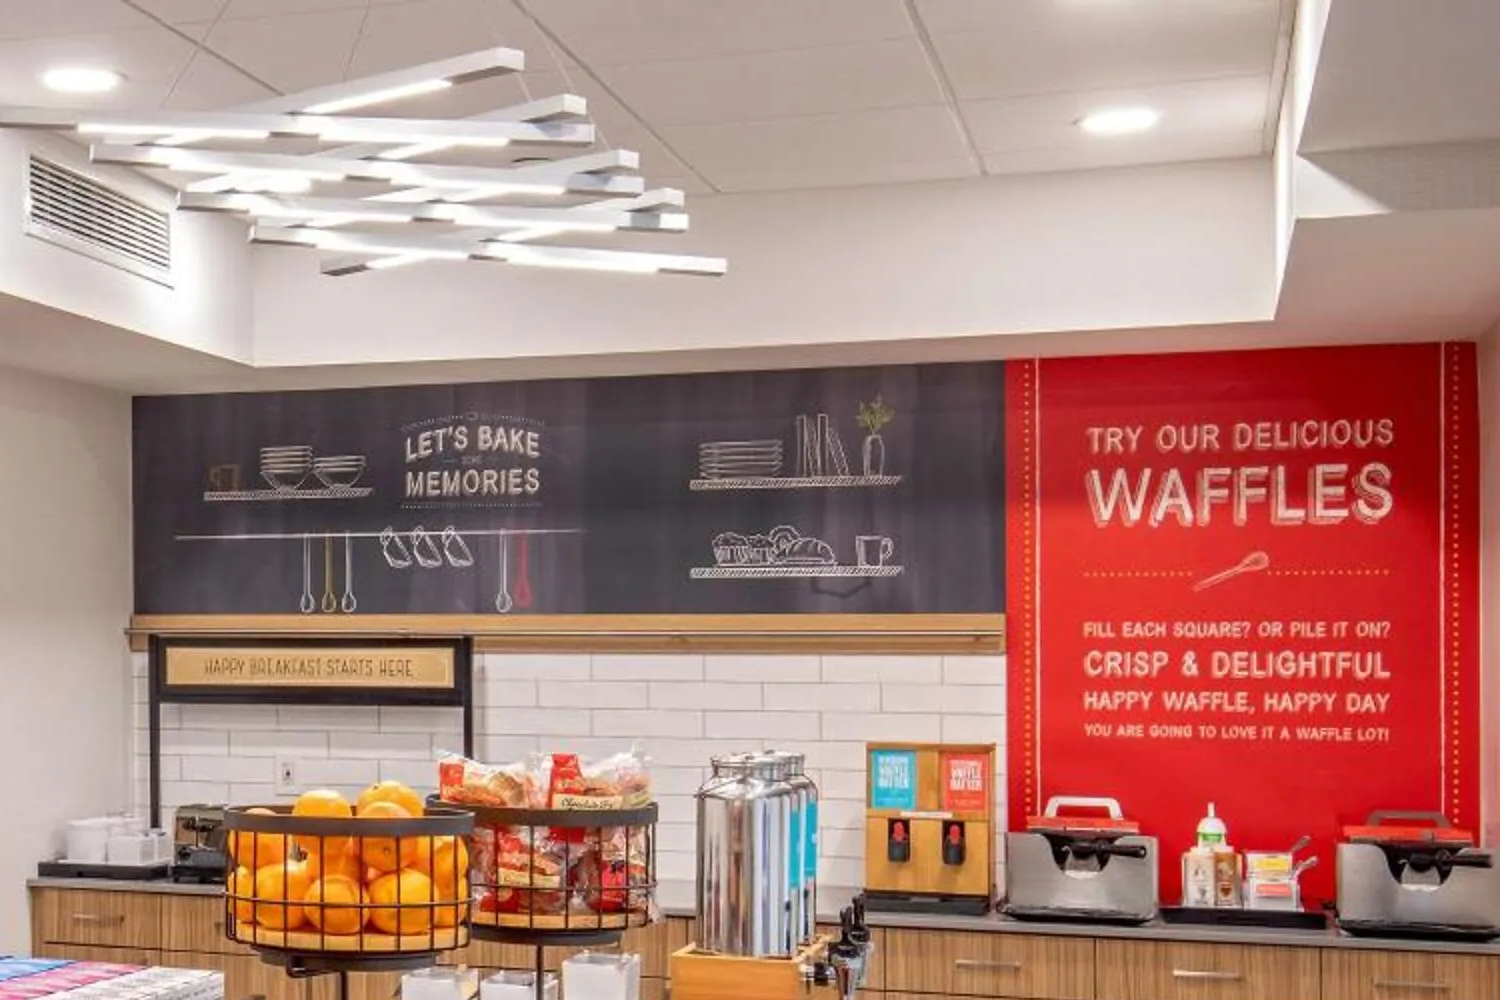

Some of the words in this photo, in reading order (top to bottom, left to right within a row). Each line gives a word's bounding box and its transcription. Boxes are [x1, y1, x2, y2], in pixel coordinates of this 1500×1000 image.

[405, 425, 469, 464] LET'S
[477, 425, 541, 459] BAKE
[1086, 426, 1143, 454] TRY
[1156, 424, 1221, 451] OUR
[1232, 418, 1395, 450] DELICIOUS
[405, 467, 541, 499] MEMORIES
[1085, 461, 1395, 528] WAFFLES
[1083, 620, 1116, 639] FILL
[1122, 620, 1167, 639] EACH
[1172, 620, 1251, 639] SQUARE?
[1257, 620, 1284, 639] OR
[1289, 620, 1327, 639] PILE
[1332, 620, 1349, 639] IT
[1355, 620, 1392, 639] ON?
[204, 657, 245, 676] HAPPY
[249, 657, 322, 677] BREAKFAST
[326, 658, 374, 678] STARTS
[379, 659, 414, 679] HERE
[1083, 650, 1170, 679] CRISP
[1180, 650, 1199, 678] &
[1211, 650, 1392, 680] DELIGHTFUL
[1083, 690, 1153, 712] HAPPY
[1162, 690, 1256, 715] WAFFLE,
[1263, 691, 1338, 713] HAPPY
[1345, 692, 1391, 714] DAY
[1084, 723, 1112, 738] YOU
[1116, 723, 1145, 738] ARE
[1149, 724, 1193, 738] GOING
[1199, 724, 1217, 739] TO
[1221, 725, 1257, 740] LOVE
[1261, 725, 1275, 740] IT
[1279, 726, 1291, 740] A
[1295, 726, 1353, 741] WAFFLE
[1357, 727, 1391, 742] LOT!
